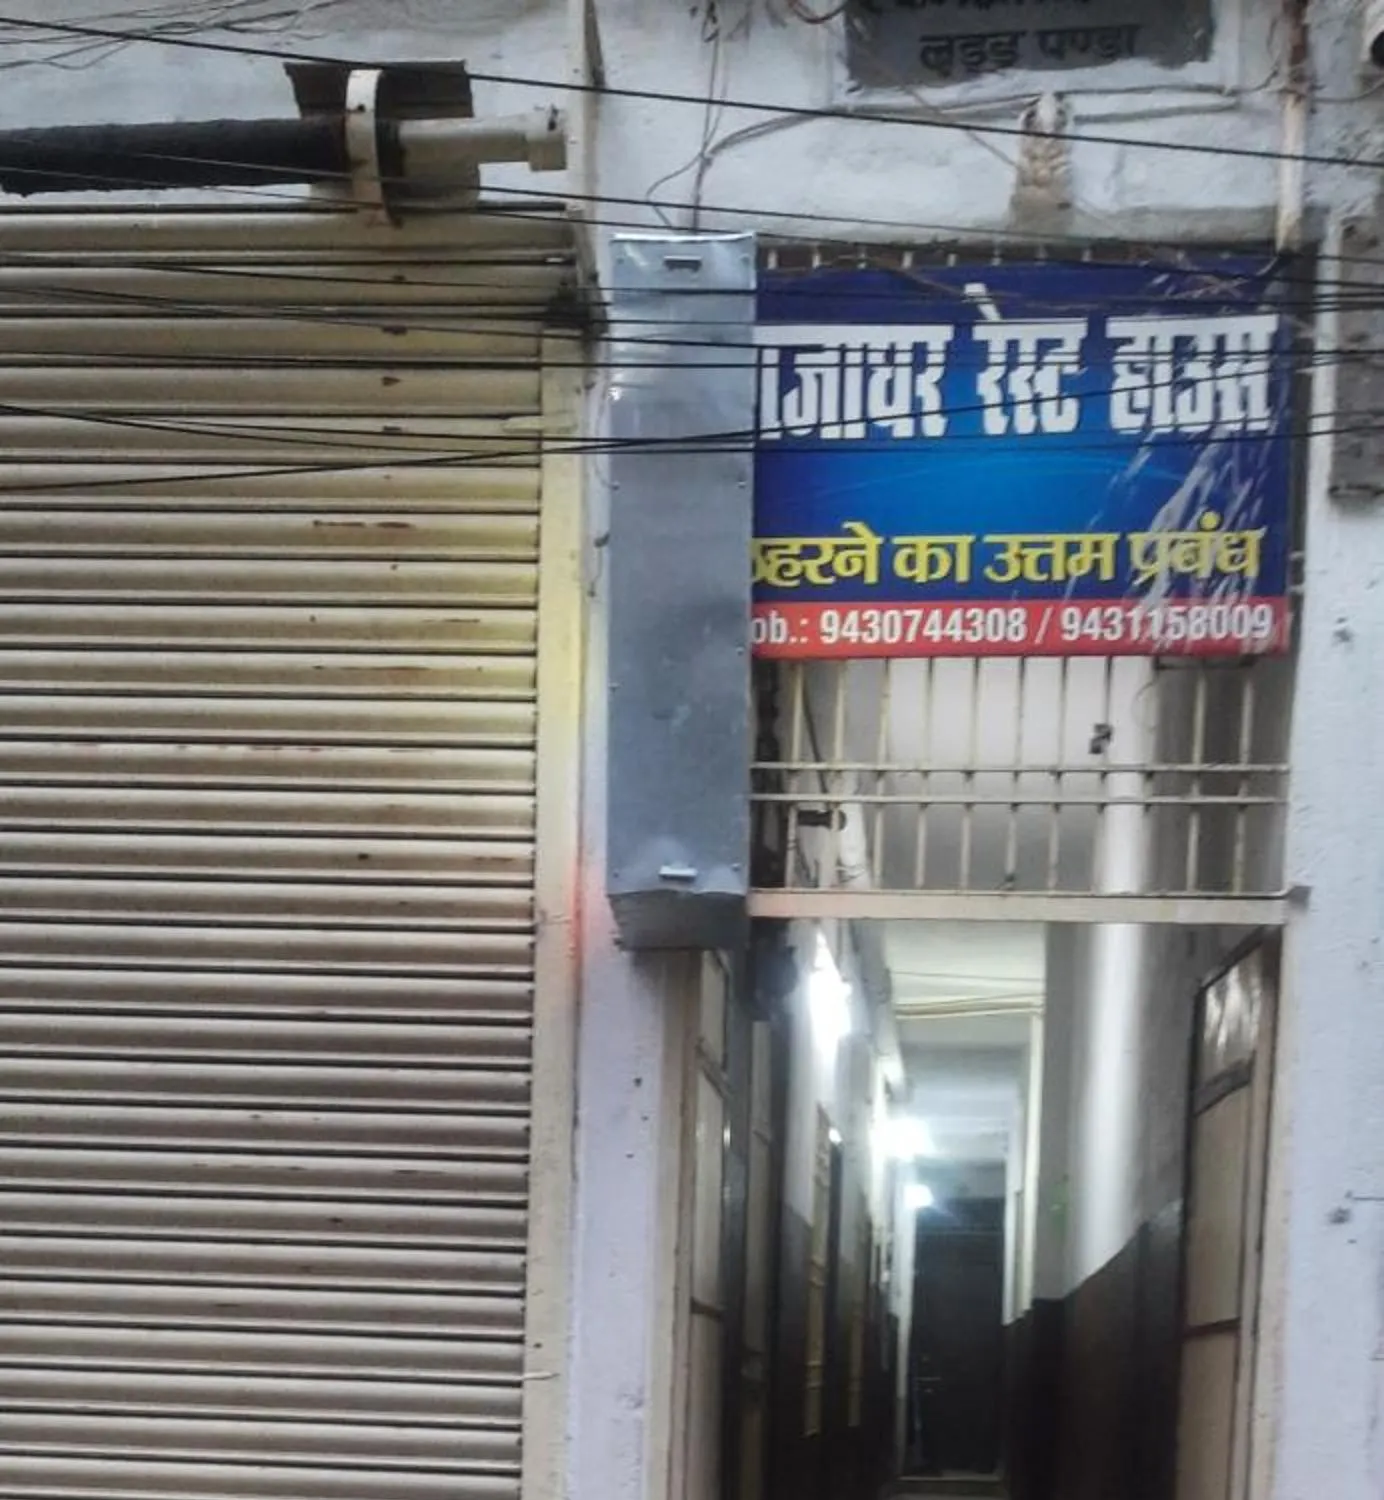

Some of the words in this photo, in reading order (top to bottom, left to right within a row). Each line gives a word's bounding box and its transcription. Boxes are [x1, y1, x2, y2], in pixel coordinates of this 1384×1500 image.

[1105, 314, 1279, 433] हाउस
[892, 535, 976, 583] का
[983, 533, 1120, 583] उत्तम
[1127, 511, 1267, 586] प्रबंध
[751, 610, 809, 645] ob.:
[820, 608, 1028, 645] 9430744308
[1035, 606, 1053, 644] /
[1060, 604, 1272, 642] 9431158009
